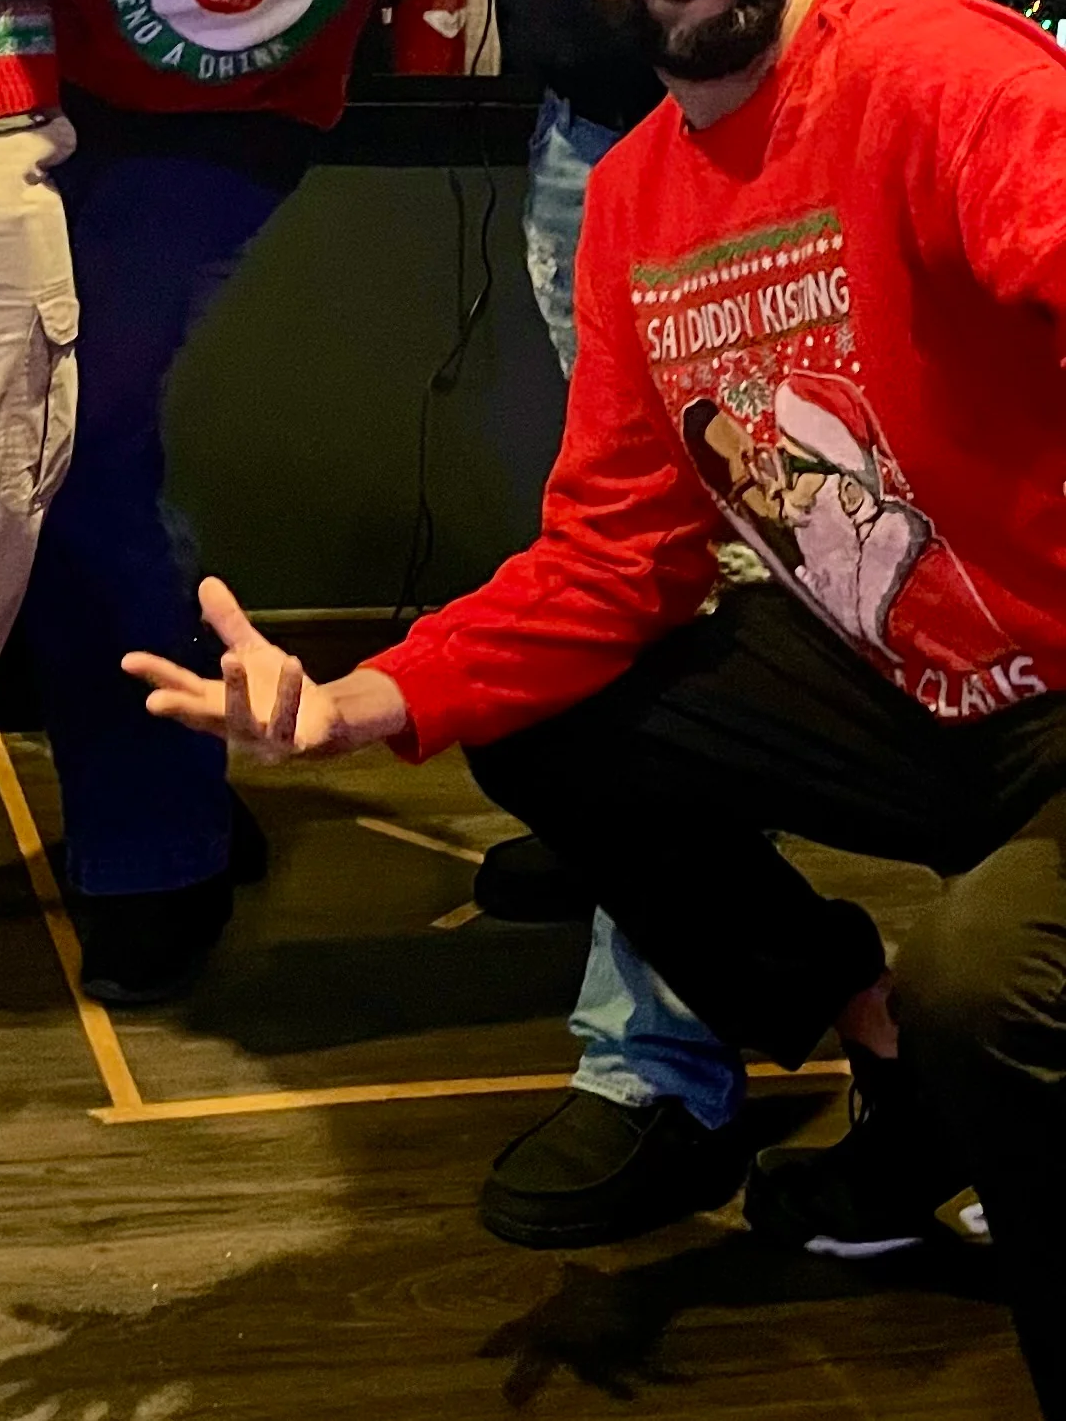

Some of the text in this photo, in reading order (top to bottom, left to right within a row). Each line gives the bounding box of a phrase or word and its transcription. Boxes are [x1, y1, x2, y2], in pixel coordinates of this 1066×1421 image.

[161, 41, 186, 67] A
[198, 38, 290, 79] DRINK
[687, 292, 754, 353] DIDDY
